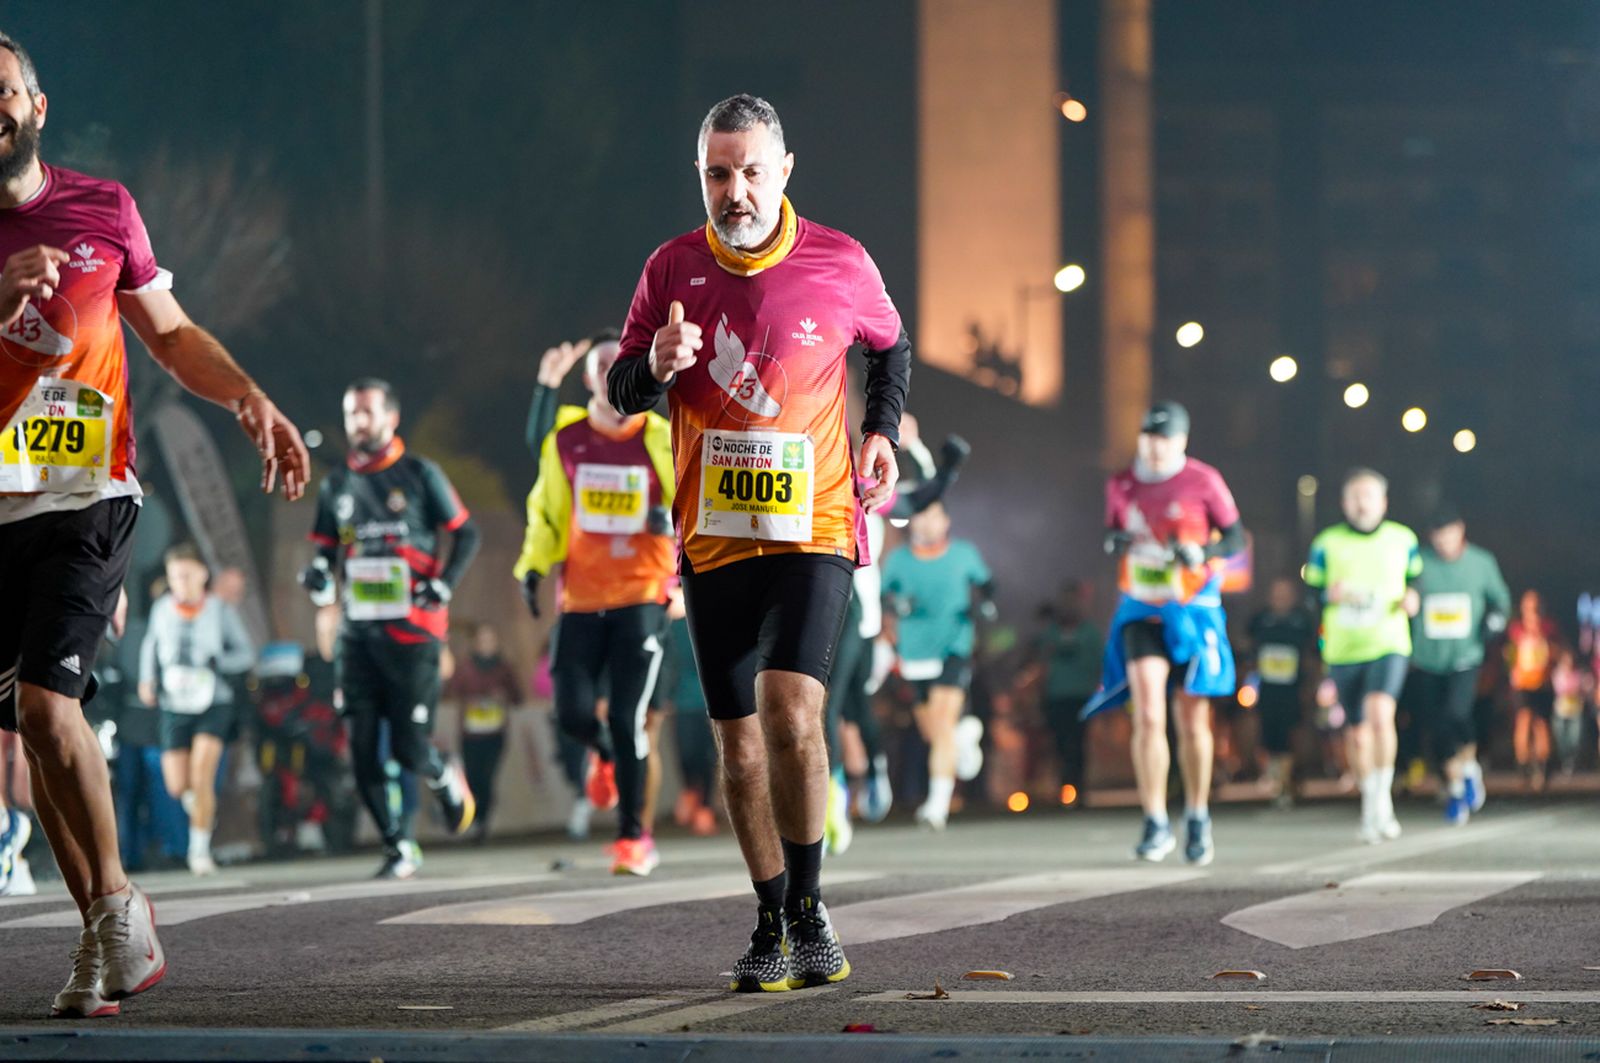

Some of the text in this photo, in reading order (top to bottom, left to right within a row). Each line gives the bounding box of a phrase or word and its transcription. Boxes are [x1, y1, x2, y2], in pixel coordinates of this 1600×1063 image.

[728, 370, 757, 400] 43
[52, 391, 67, 402] DE
[723, 442, 757, 454] NOCHE
[759, 444, 773, 455] DE
[711, 455, 732, 467] SAN
[734, 453, 772, 469] ANTÓN
[718, 469, 793, 503] 4003
[731, 502, 778, 514] JOSE MANUEL
